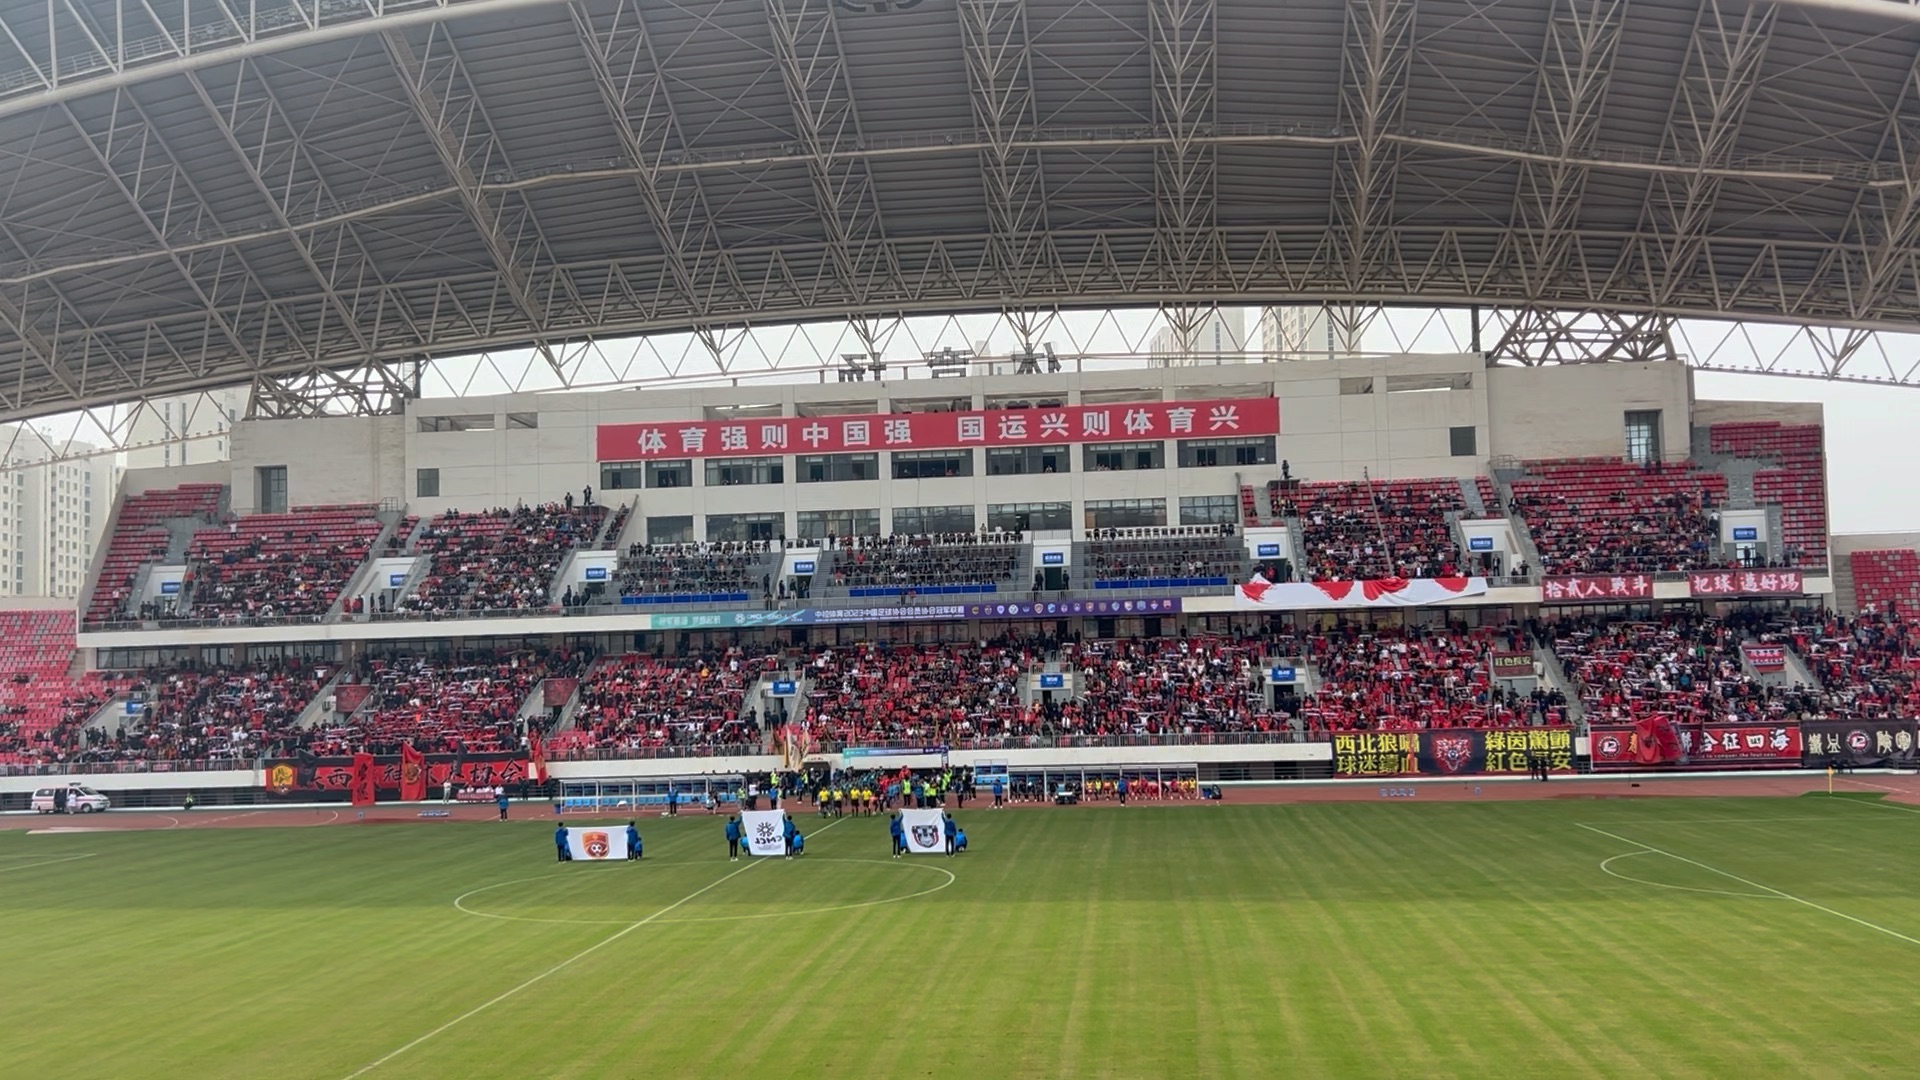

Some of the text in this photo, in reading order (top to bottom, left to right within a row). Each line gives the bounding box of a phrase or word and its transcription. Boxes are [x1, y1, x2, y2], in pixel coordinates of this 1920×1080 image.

[637, 405, 1240, 455] 体育强则中国强 国运兴则体育兴
